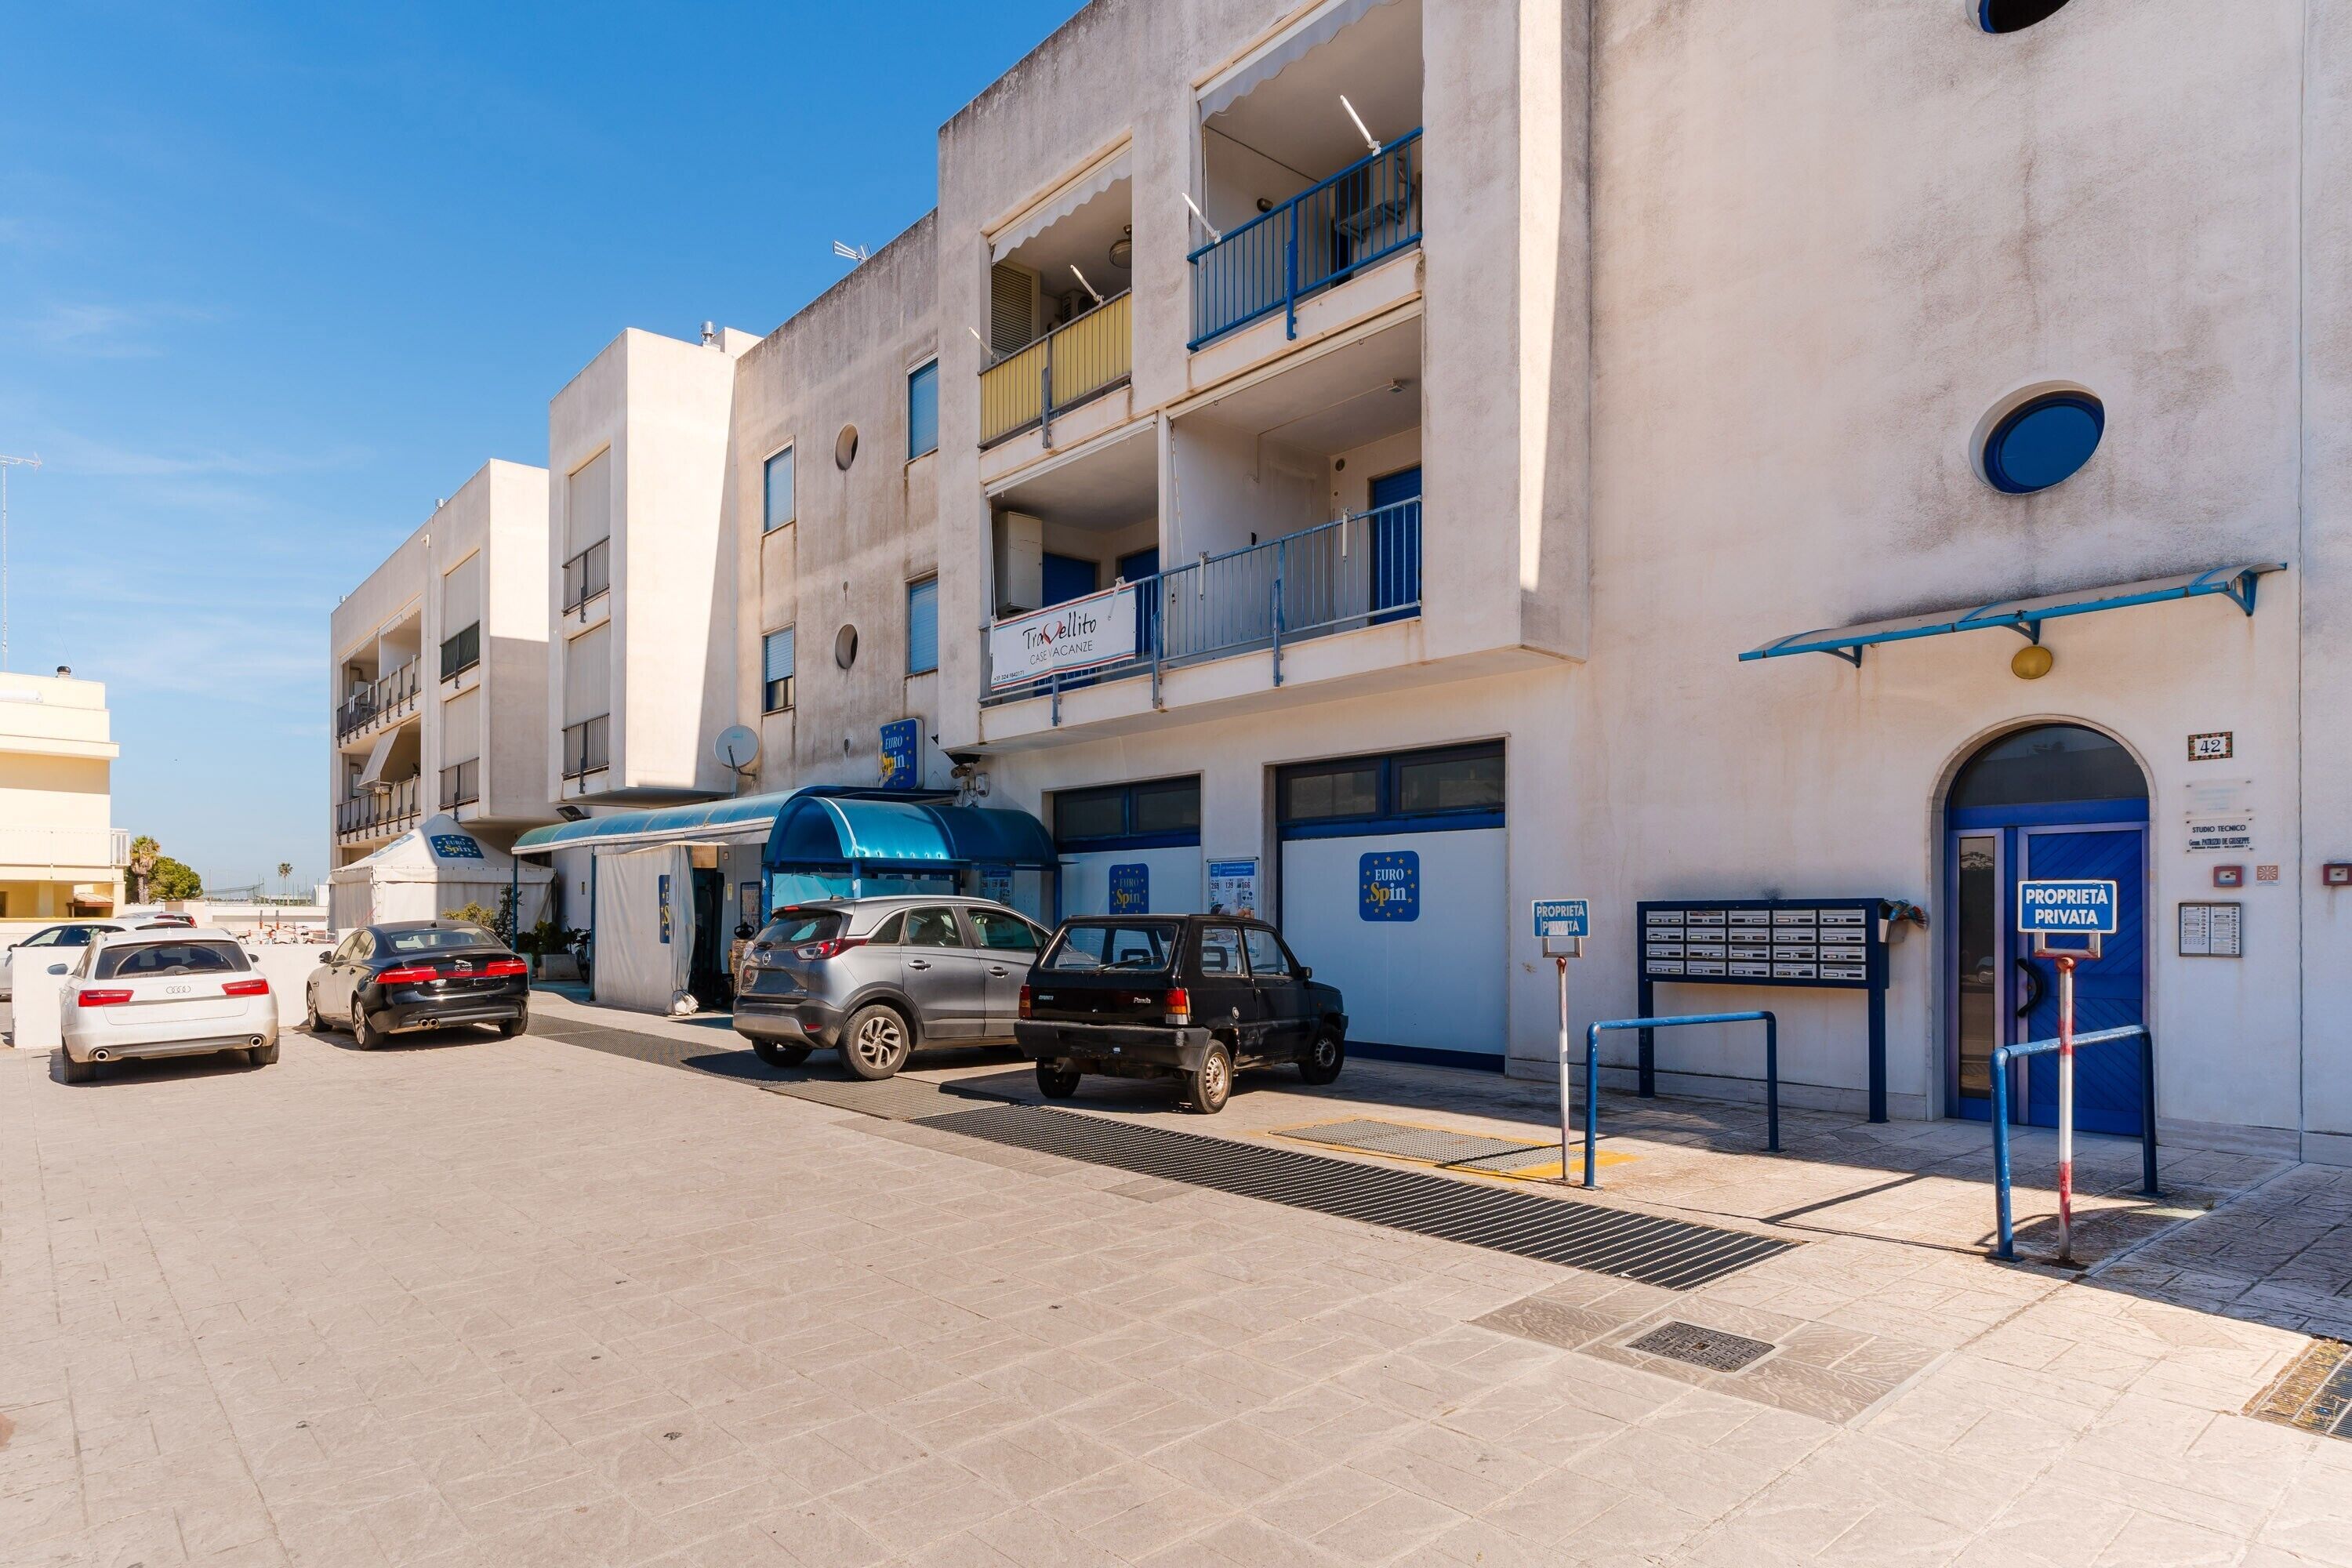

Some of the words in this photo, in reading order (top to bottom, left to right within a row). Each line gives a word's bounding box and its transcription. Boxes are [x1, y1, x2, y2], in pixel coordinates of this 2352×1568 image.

[1029, 649, 1047, 666] CASE
[1048, 640, 1094, 658] VACANZE
[884, 735, 903, 750] EURO
[2200, 739, 2221, 753] 42
[445, 845, 472, 854] Spin
[1120, 878, 1139, 887] EURO
[1374, 868, 1404, 881] EURO
[1116, 888, 1141, 909] Spin
[1370, 882, 1406, 907] Spin
[2025, 884, 2109, 905] PROPRIETÀ
[1536, 902, 1585, 918] PROPRIETÀ
[2034, 909, 2099, 925] PRIVATA
